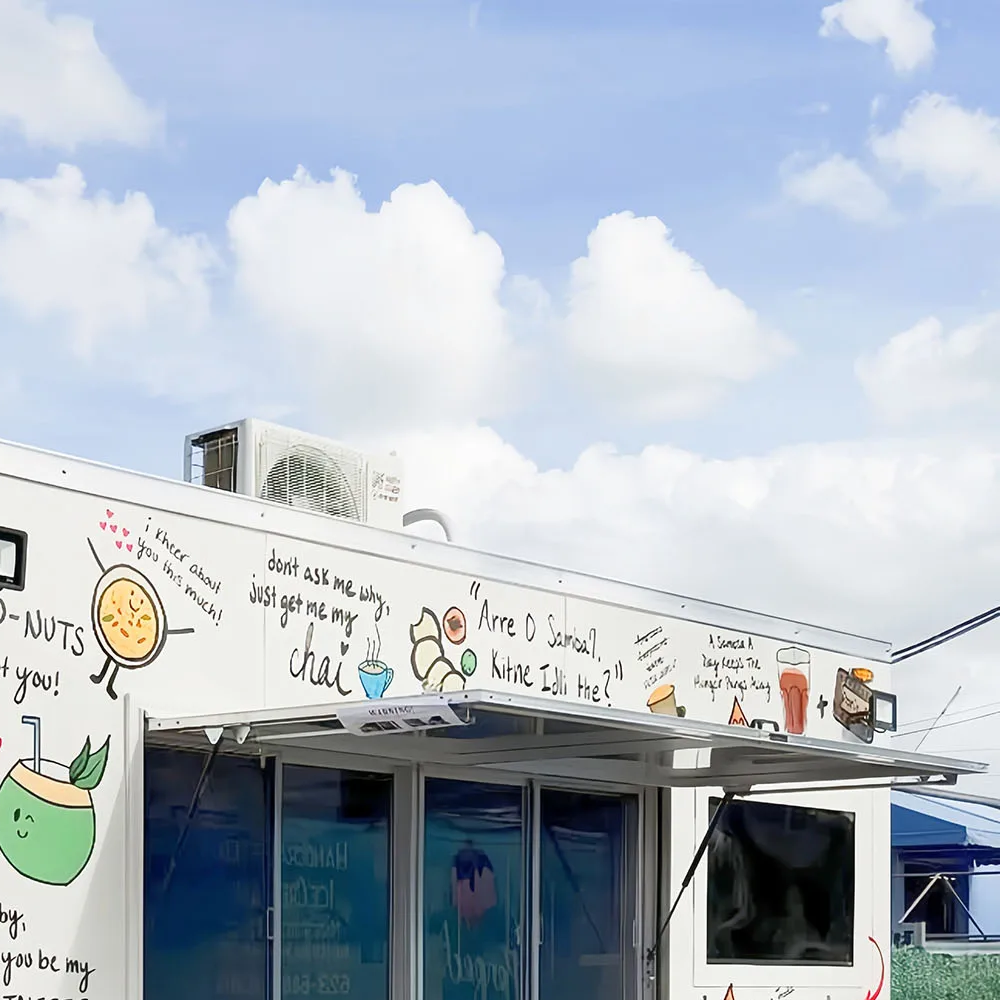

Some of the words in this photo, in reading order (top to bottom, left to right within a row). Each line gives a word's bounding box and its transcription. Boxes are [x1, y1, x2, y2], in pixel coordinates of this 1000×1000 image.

[137, 537, 159, 562] you
[163, 560, 183, 587] this
[185, 584, 223, 626] much!
[189, 564, 221, 594] about
[304, 567, 329, 585] ask
[333, 576, 356, 597] me
[359, 585, 390, 622] why,
[250, 573, 276, 608] just
[280, 593, 303, 628] get
[306, 600, 327, 620] me
[331, 607, 358, 638] my
[525, 612, 536, 642] O
[290, 622, 352, 696] chai
[491, 648, 533, 687] Kitne
[539, 664, 568, 696] Idli
[16, 670, 61, 704] you!
[1, 948, 33, 987] you
[39, 949, 60, 972] be
[65, 957, 96, 993] my
